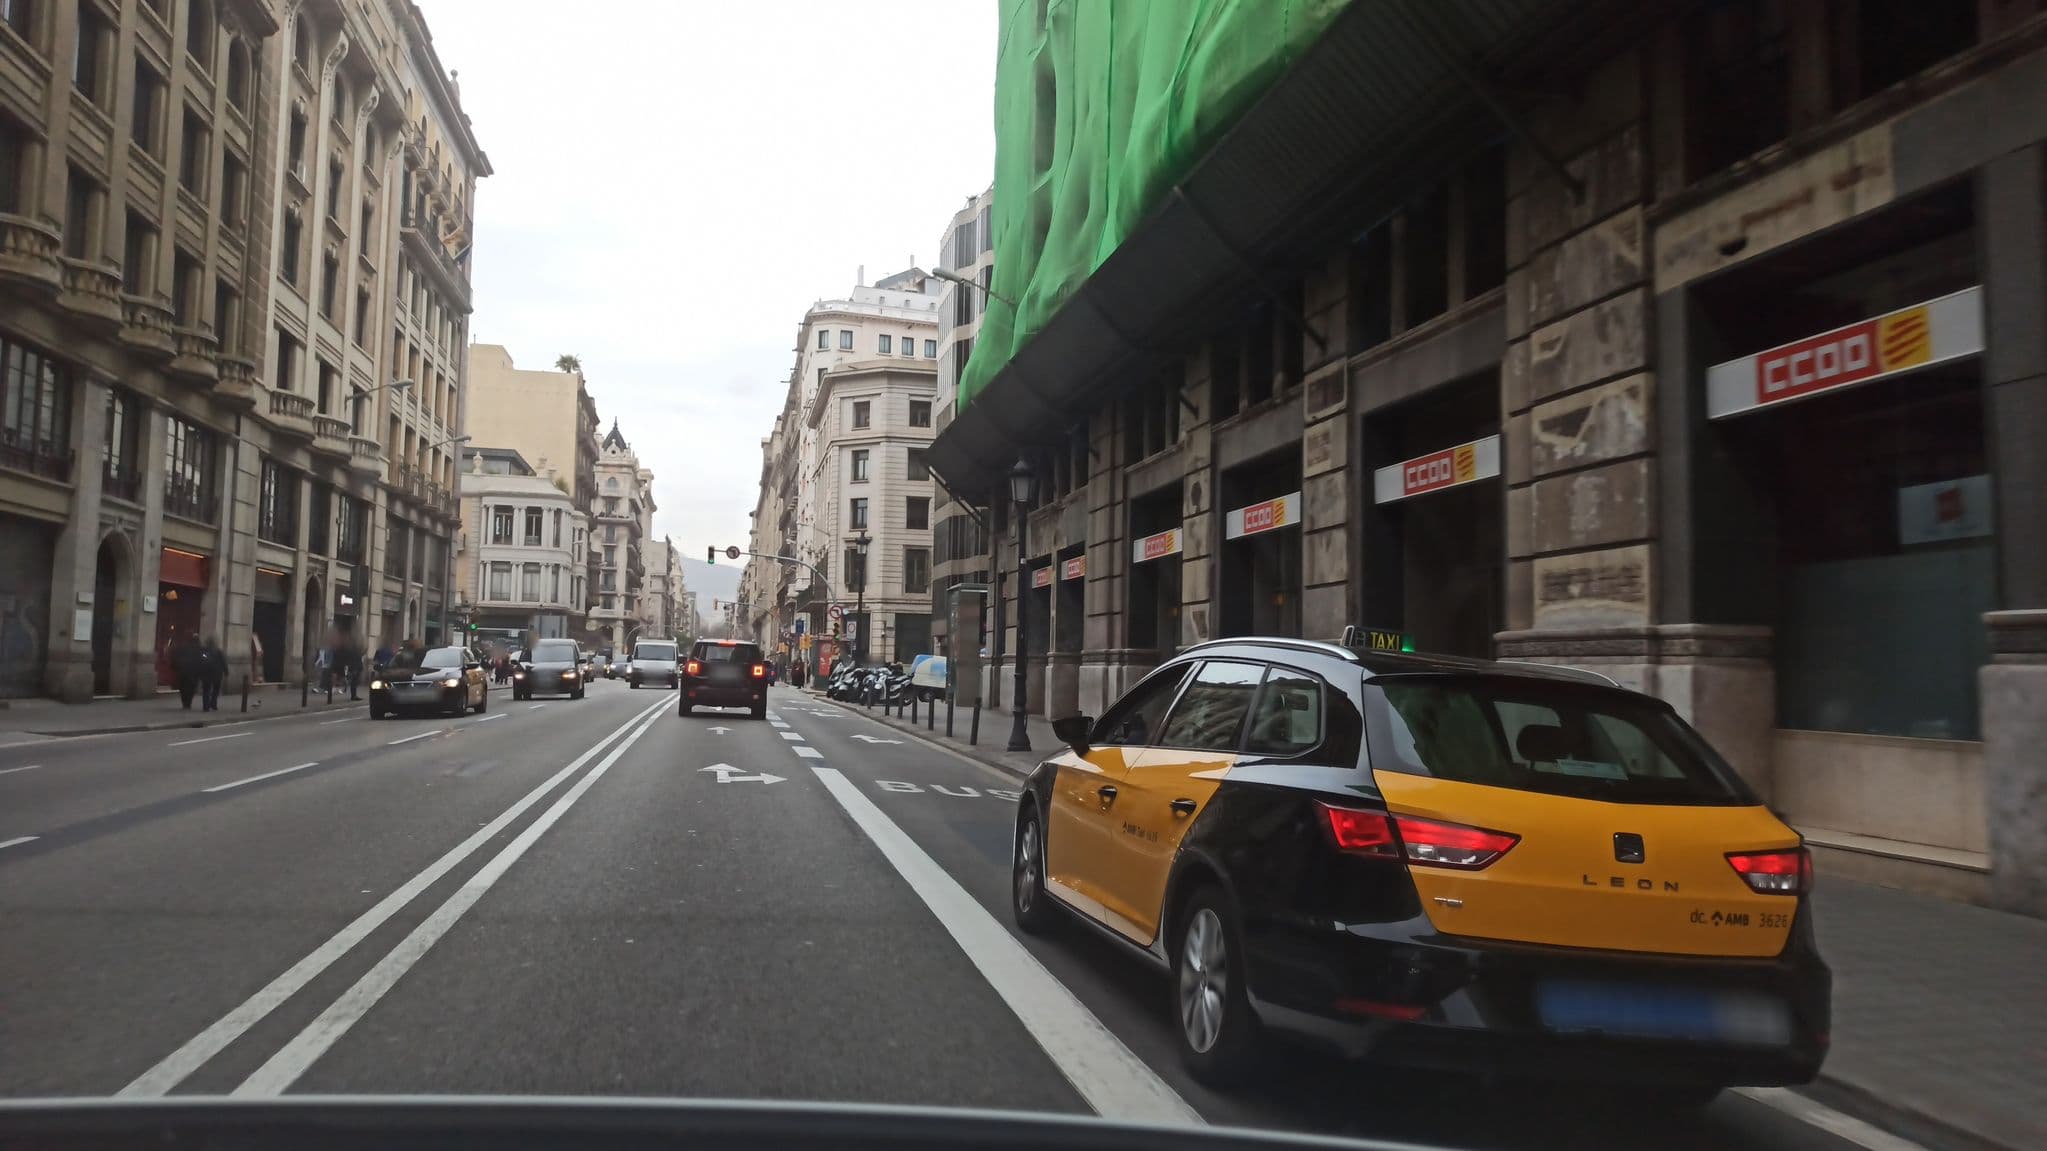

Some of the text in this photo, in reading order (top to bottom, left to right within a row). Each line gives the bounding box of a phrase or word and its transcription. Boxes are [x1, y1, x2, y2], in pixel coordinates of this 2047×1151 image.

[1764, 333, 1870, 394] CCOO
[1406, 457, 1452, 489] CCOO
[1245, 507, 1273, 530] CCOO
[1370, 632, 1400, 651] TAXI
[1582, 874, 1680, 893] LEON
[1725, 912, 1750, 927] AMB
[1759, 912, 1789, 929] 3626
